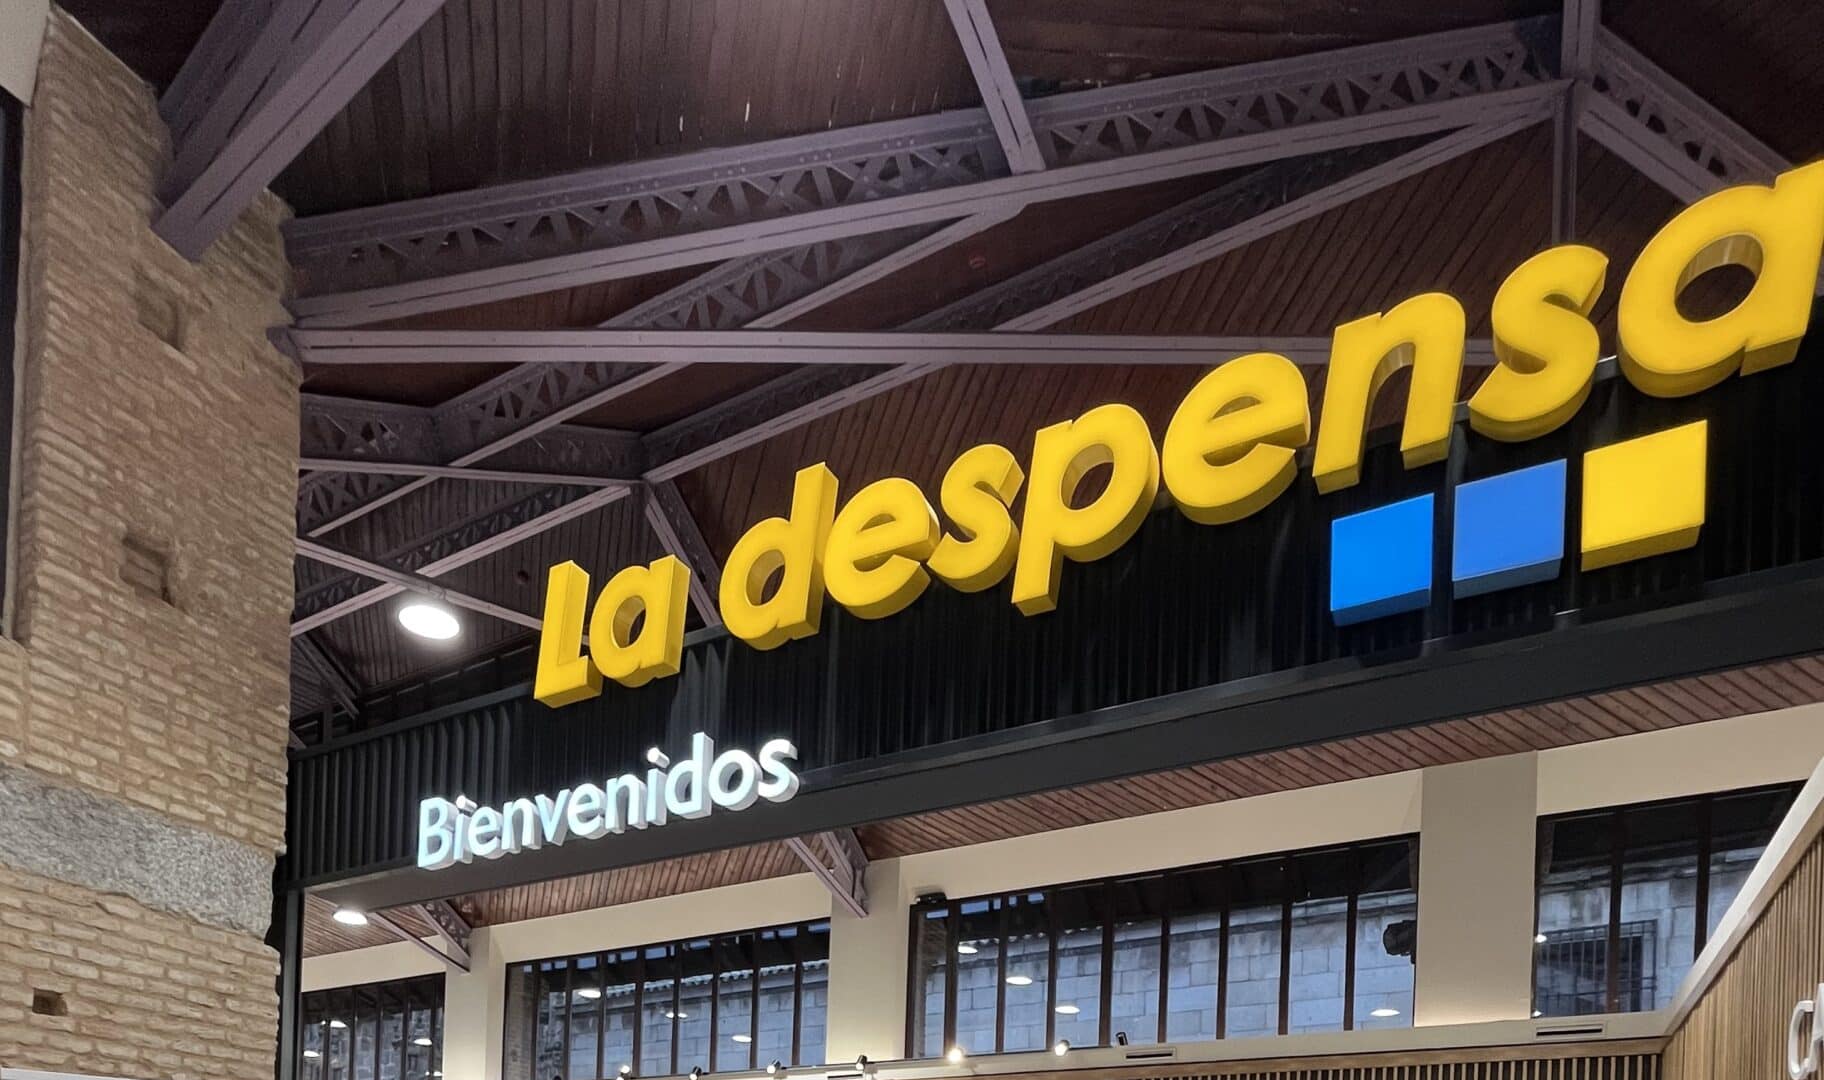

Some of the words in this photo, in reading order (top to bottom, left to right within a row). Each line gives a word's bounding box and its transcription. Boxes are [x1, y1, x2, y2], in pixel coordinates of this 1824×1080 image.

[534, 554, 691, 708] La
[719, 158, 1824, 651] despensa
[417, 732, 799, 870] Bienvenidos
